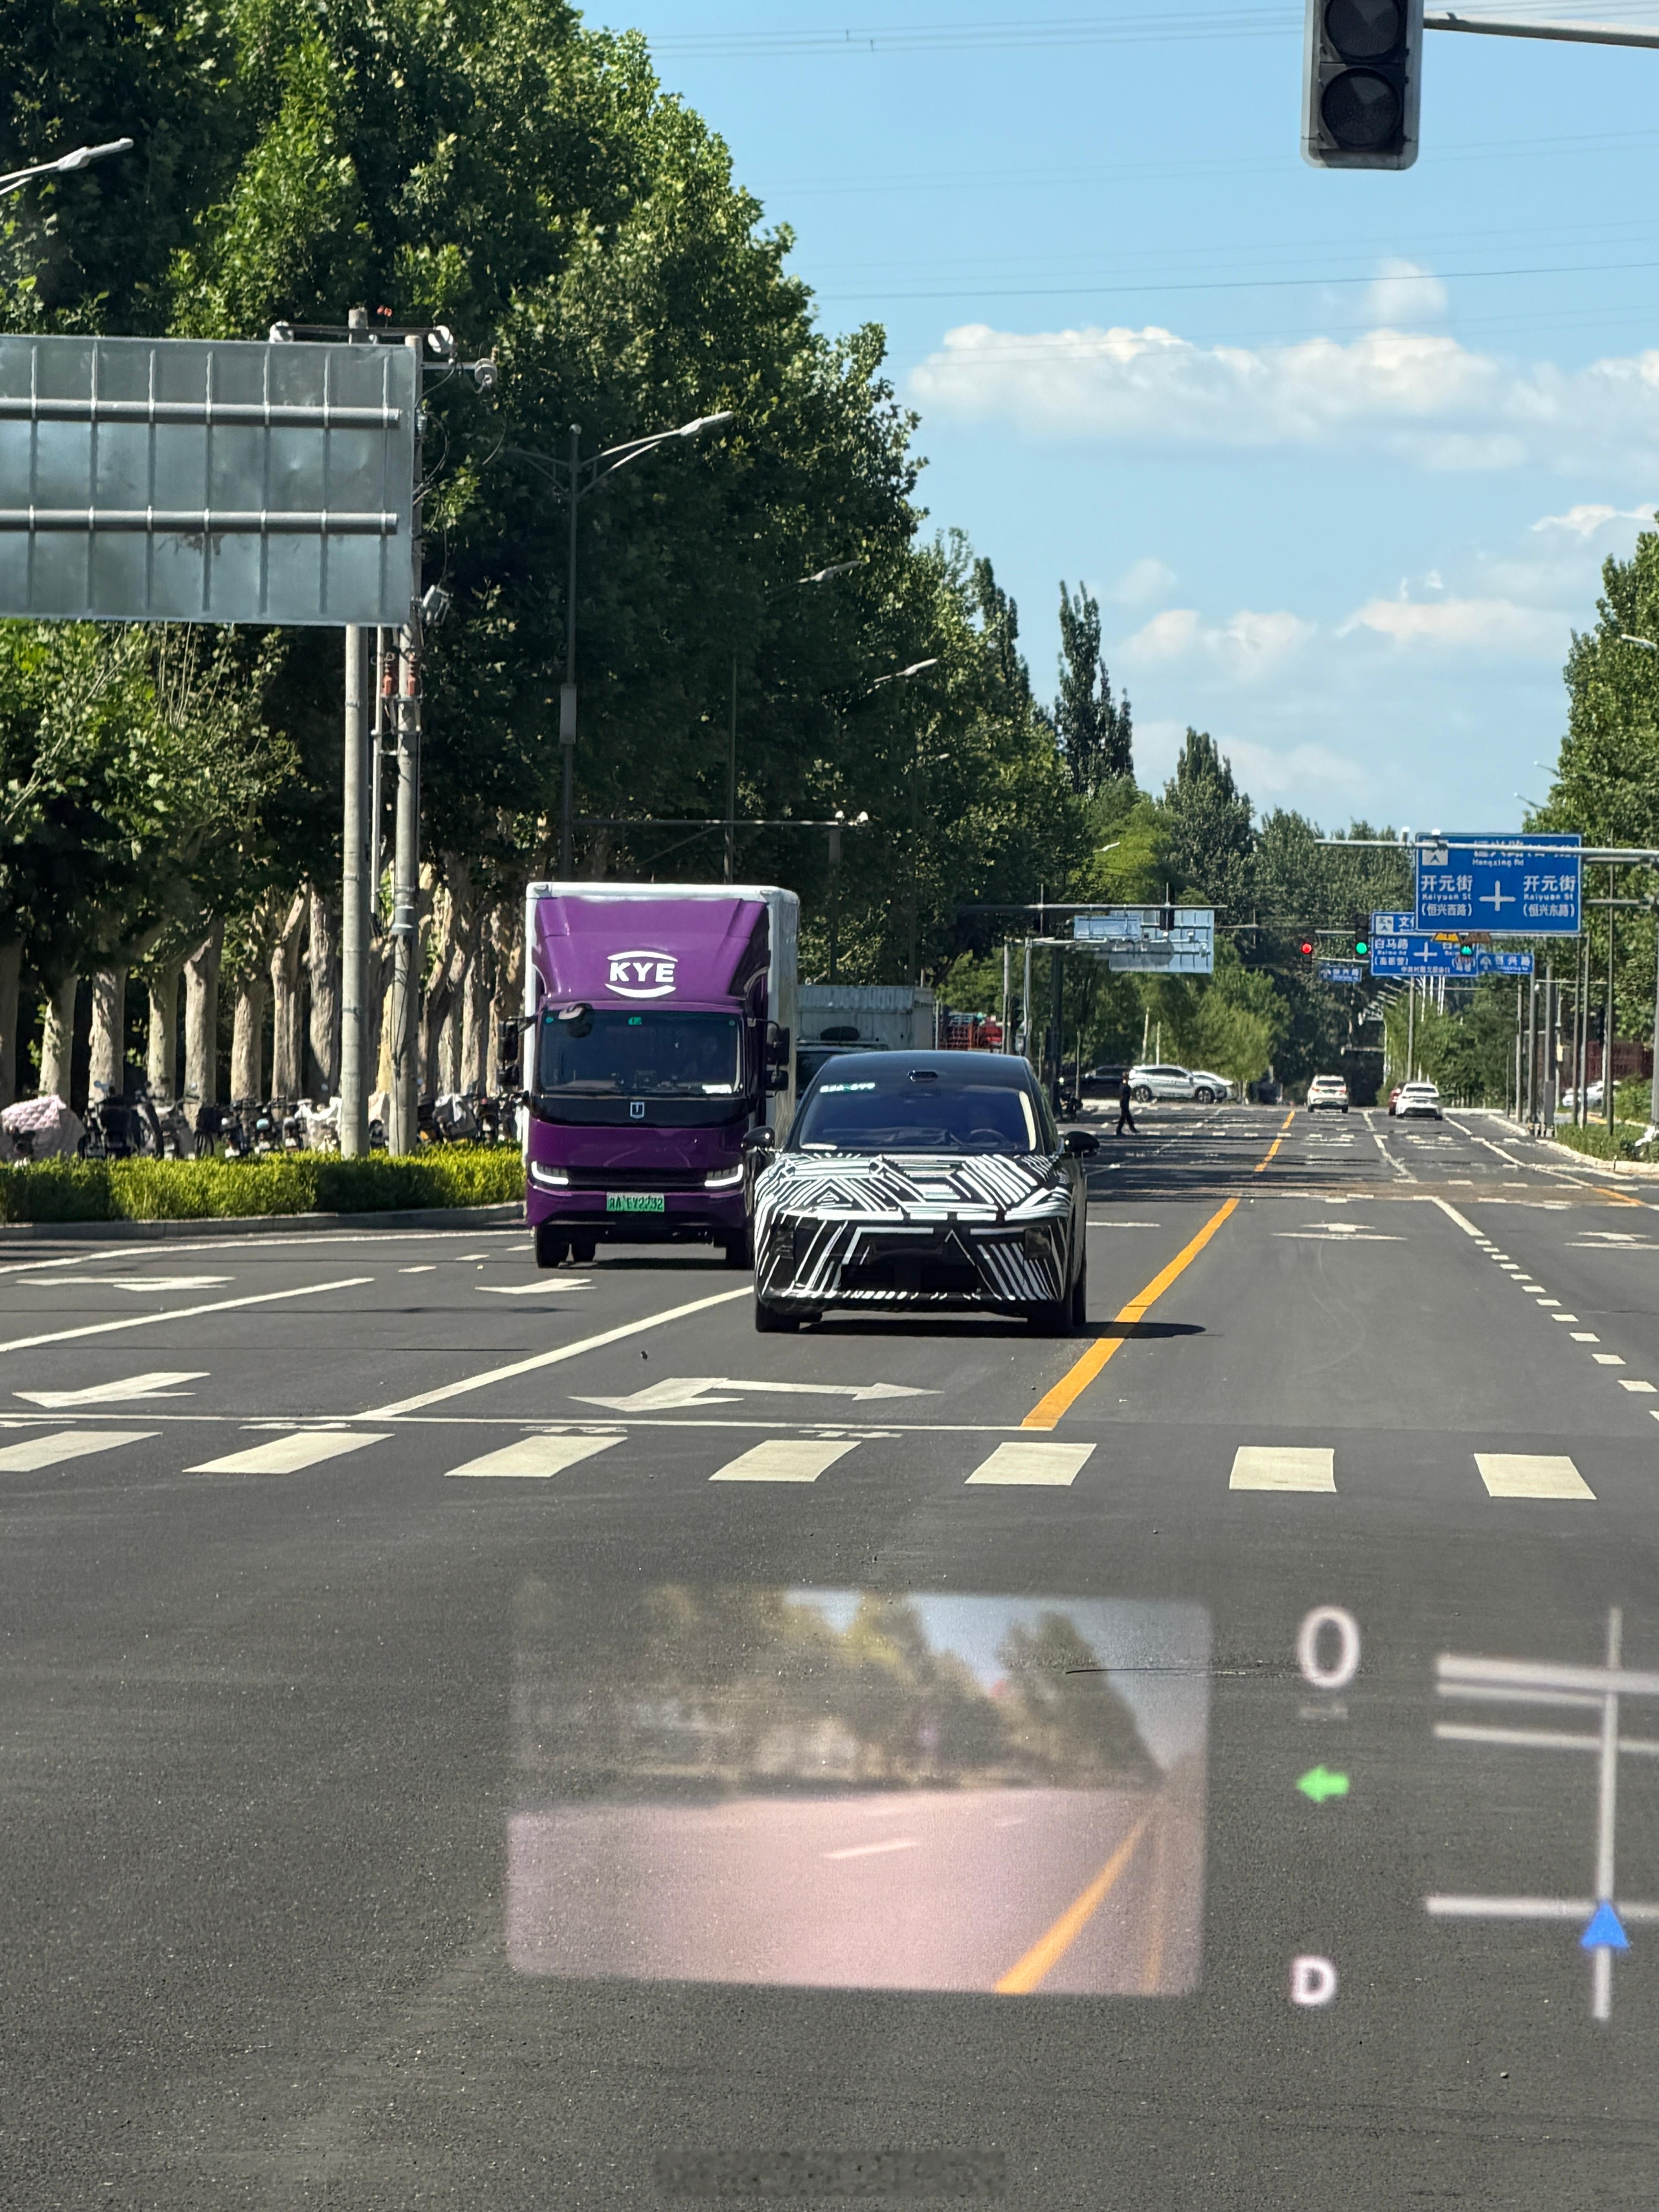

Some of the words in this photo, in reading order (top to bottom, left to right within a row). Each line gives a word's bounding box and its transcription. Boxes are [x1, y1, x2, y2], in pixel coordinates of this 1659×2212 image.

[1420, 874, 1473, 892] 开元街
[1523, 875, 1576, 892] 开元街
[1422, 893, 1459, 902] Kaiyuan
[1524, 893, 1561, 902] Kaiyuan
[610, 962, 675, 982] KYE
[1297, 1606, 1360, 1688] 0
[1290, 1955, 1338, 2006] D
